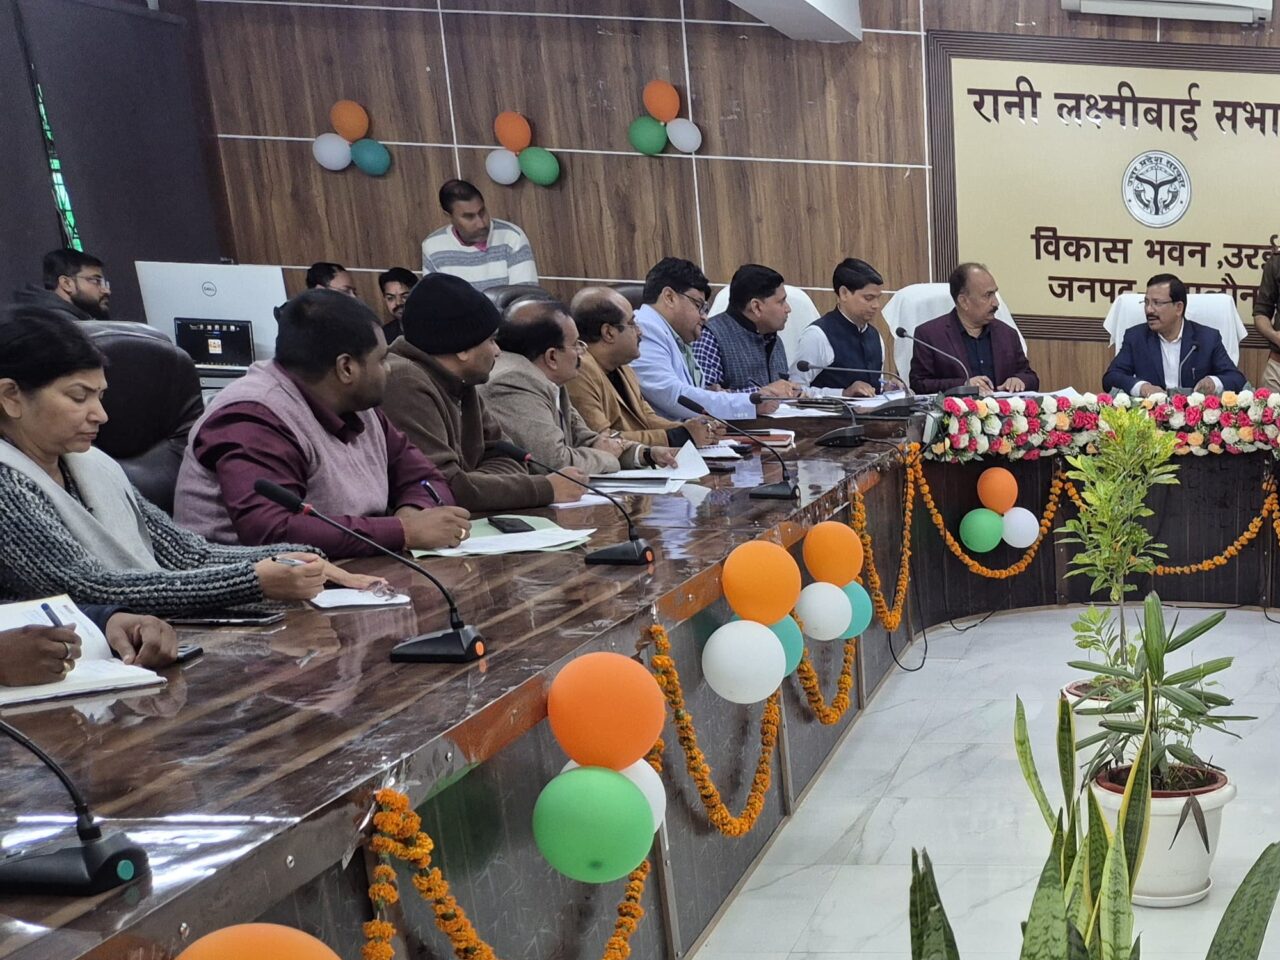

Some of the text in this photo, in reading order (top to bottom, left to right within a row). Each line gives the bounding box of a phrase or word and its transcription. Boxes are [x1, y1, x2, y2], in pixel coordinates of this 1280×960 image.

[967, 76, 1042, 125] रानी
[1054, 81, 1201, 141] लक्ष्मीबाई
[1030, 226, 1133, 264] विकास
[1144, 239, 1211, 268] भवन
